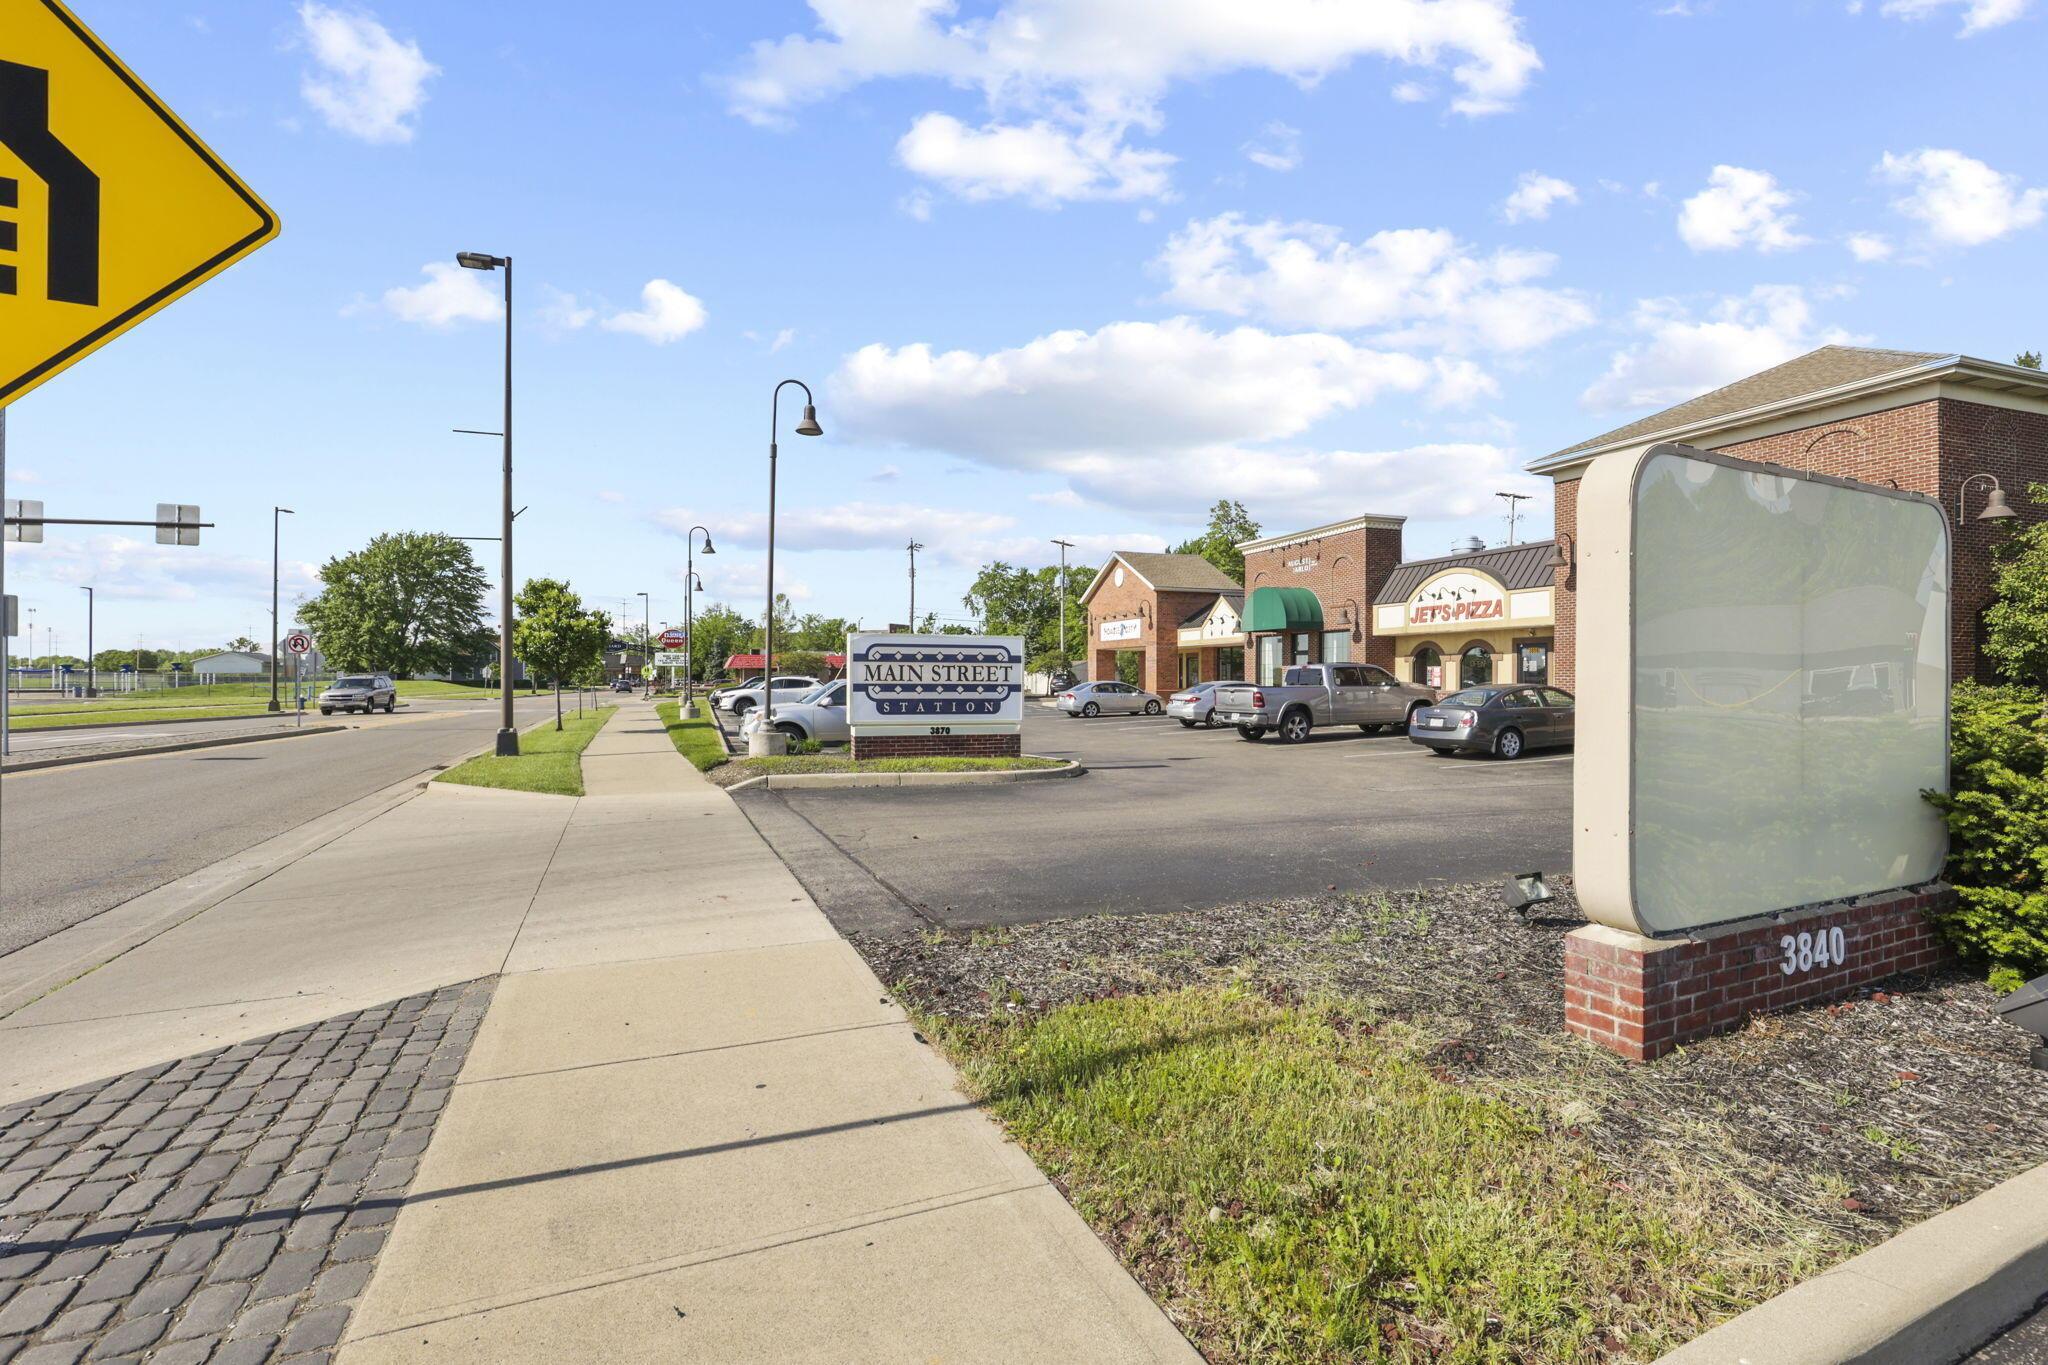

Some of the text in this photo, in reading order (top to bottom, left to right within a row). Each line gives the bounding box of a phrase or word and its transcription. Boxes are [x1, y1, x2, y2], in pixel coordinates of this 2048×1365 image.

[1411, 599, 1503, 624] JET'S PIZZA
[864, 664, 1013, 682] MAIN STREET
[883, 702, 994, 712] STATION
[929, 726, 951, 735] 3870
[1780, 926, 1845, 975] 3840
